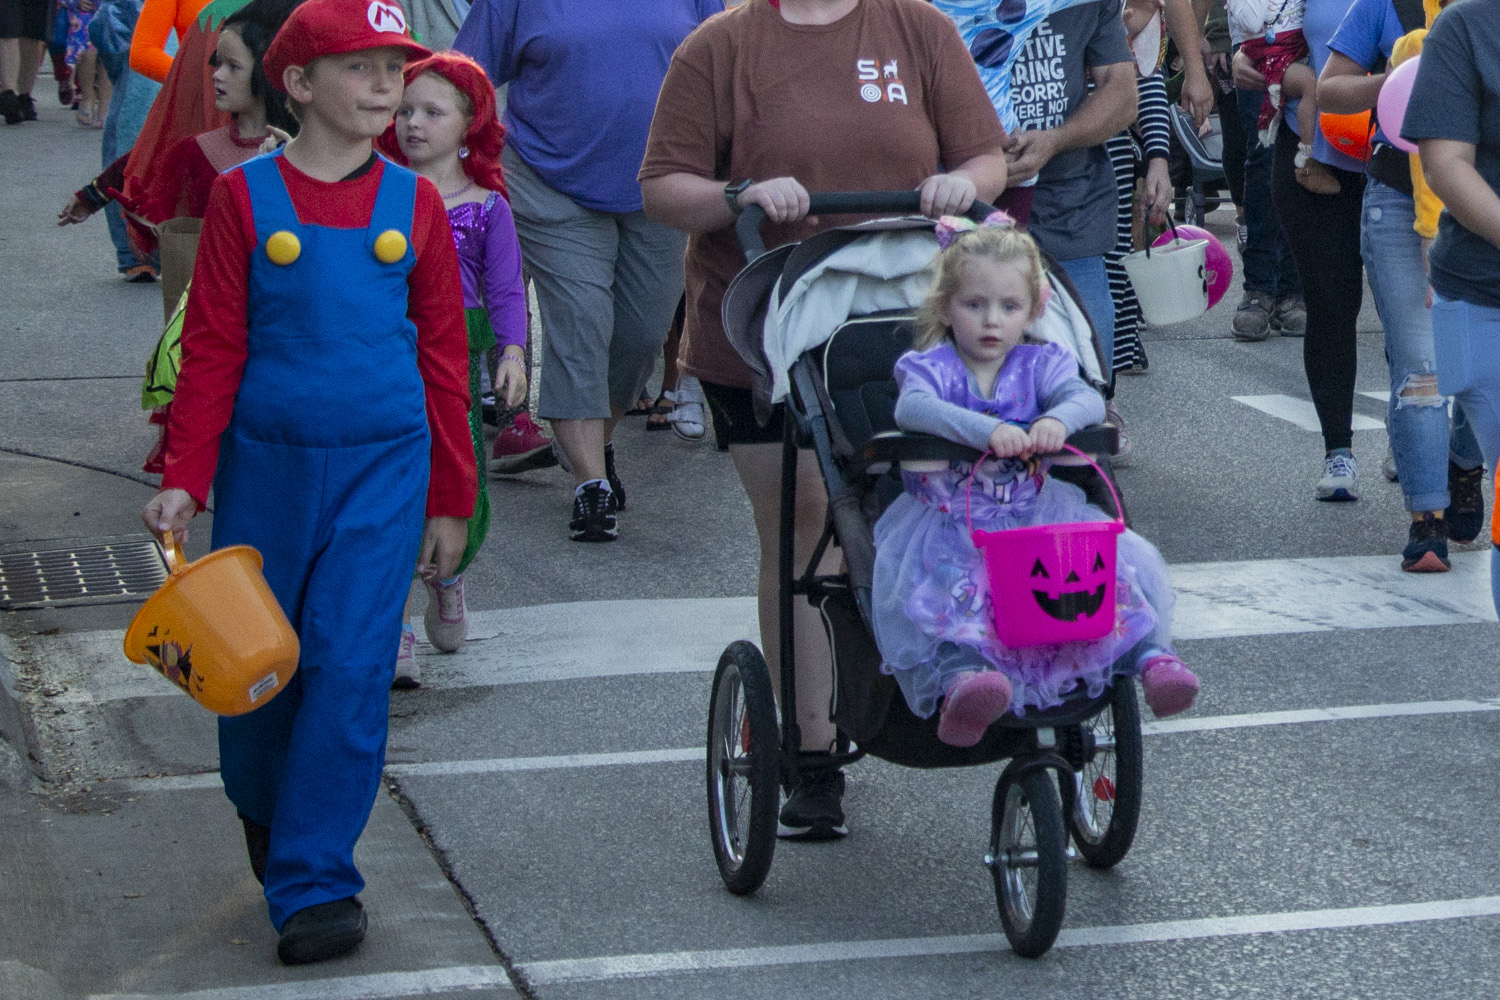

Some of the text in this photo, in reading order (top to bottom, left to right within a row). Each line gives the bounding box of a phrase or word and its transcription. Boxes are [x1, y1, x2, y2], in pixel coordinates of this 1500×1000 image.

[373, 4, 404, 30] M
[1009, 80, 1068, 105] SORRY
[1048, 97, 1069, 115] NOT
